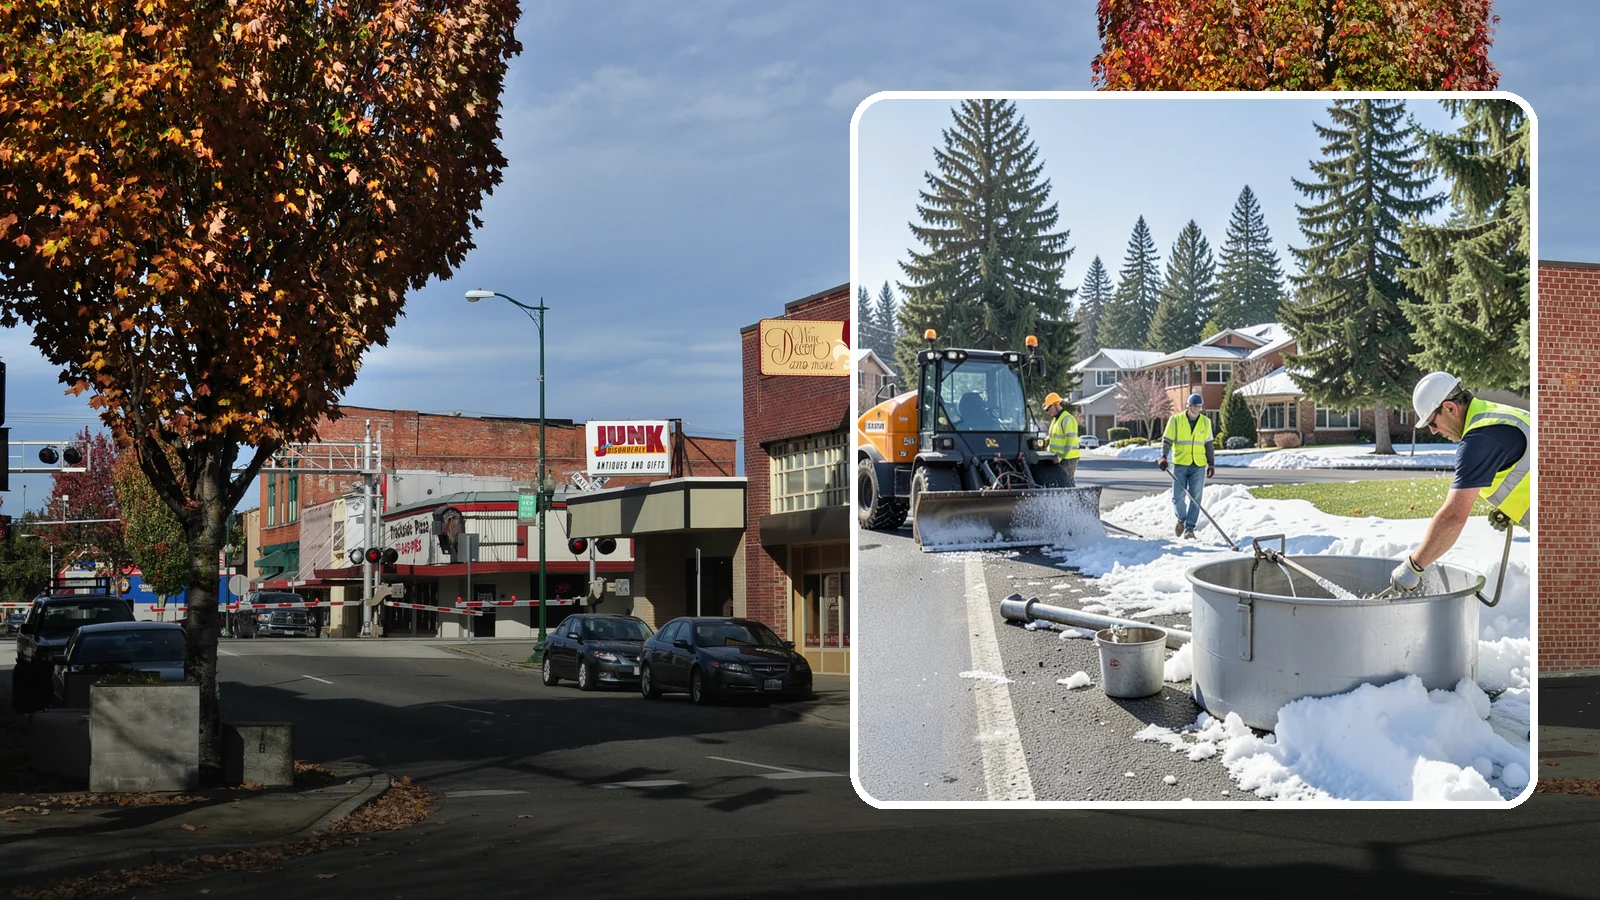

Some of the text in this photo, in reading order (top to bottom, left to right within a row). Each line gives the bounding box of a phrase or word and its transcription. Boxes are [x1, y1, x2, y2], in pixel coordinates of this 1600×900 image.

[595, 425, 665, 457] JUNK
[607, 446, 645, 454] DISORDERLY
[597, 460, 665, 470] ANTIQUES AND GIFTS
[415, 519, 429, 535] Pizza
